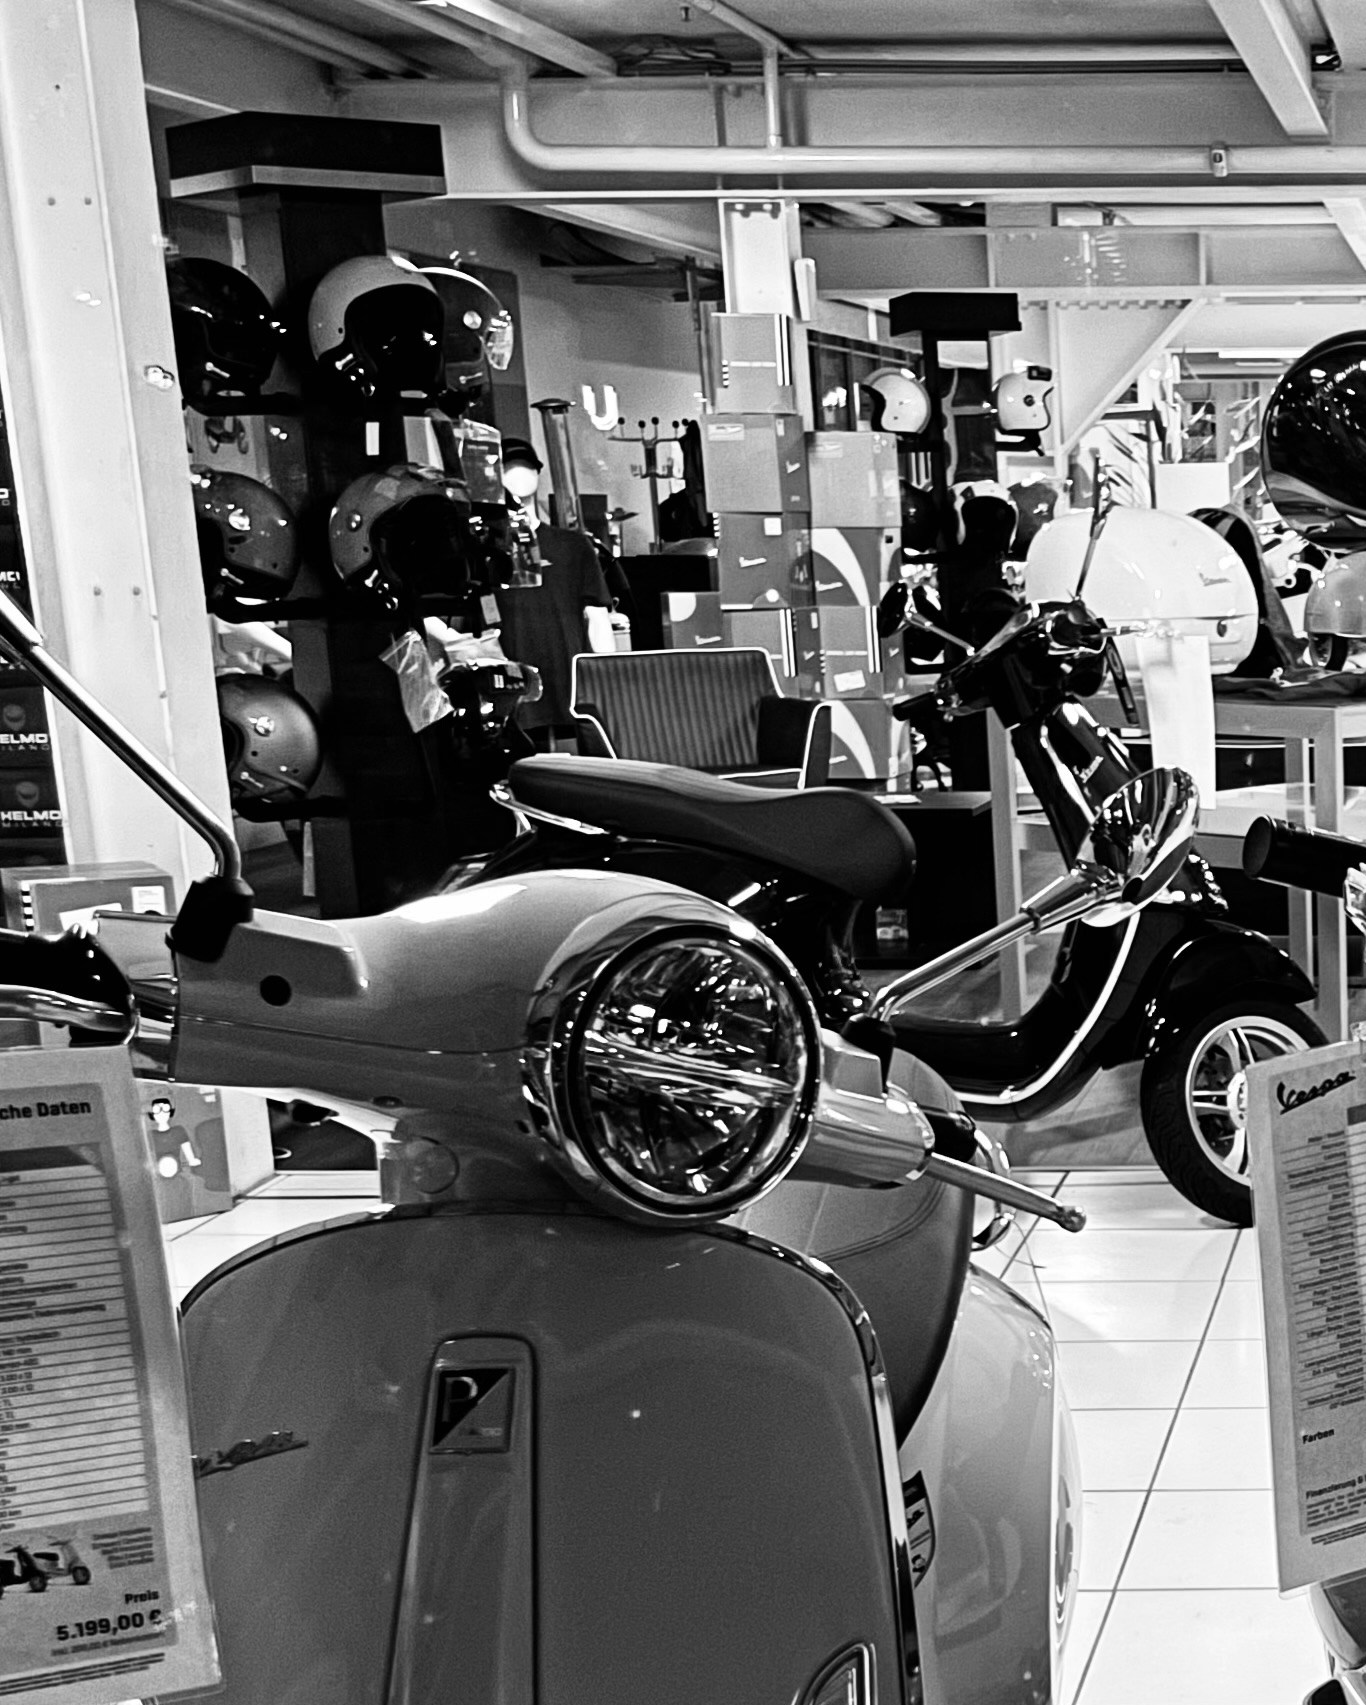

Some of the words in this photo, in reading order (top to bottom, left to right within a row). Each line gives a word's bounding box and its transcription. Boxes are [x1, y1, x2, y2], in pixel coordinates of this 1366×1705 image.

[1, 810, 61, 820] HELMO
[1276, 1070, 1357, 1115] Vespa
[36, 1101, 92, 1118] Daten
[1302, 1428, 1335, 1445] Farben
[1305, 1479, 1357, 1500] Finanzierung
[124, 1589, 160, 1605] Preis
[55, 1612, 145, 1641] 5.199,00
